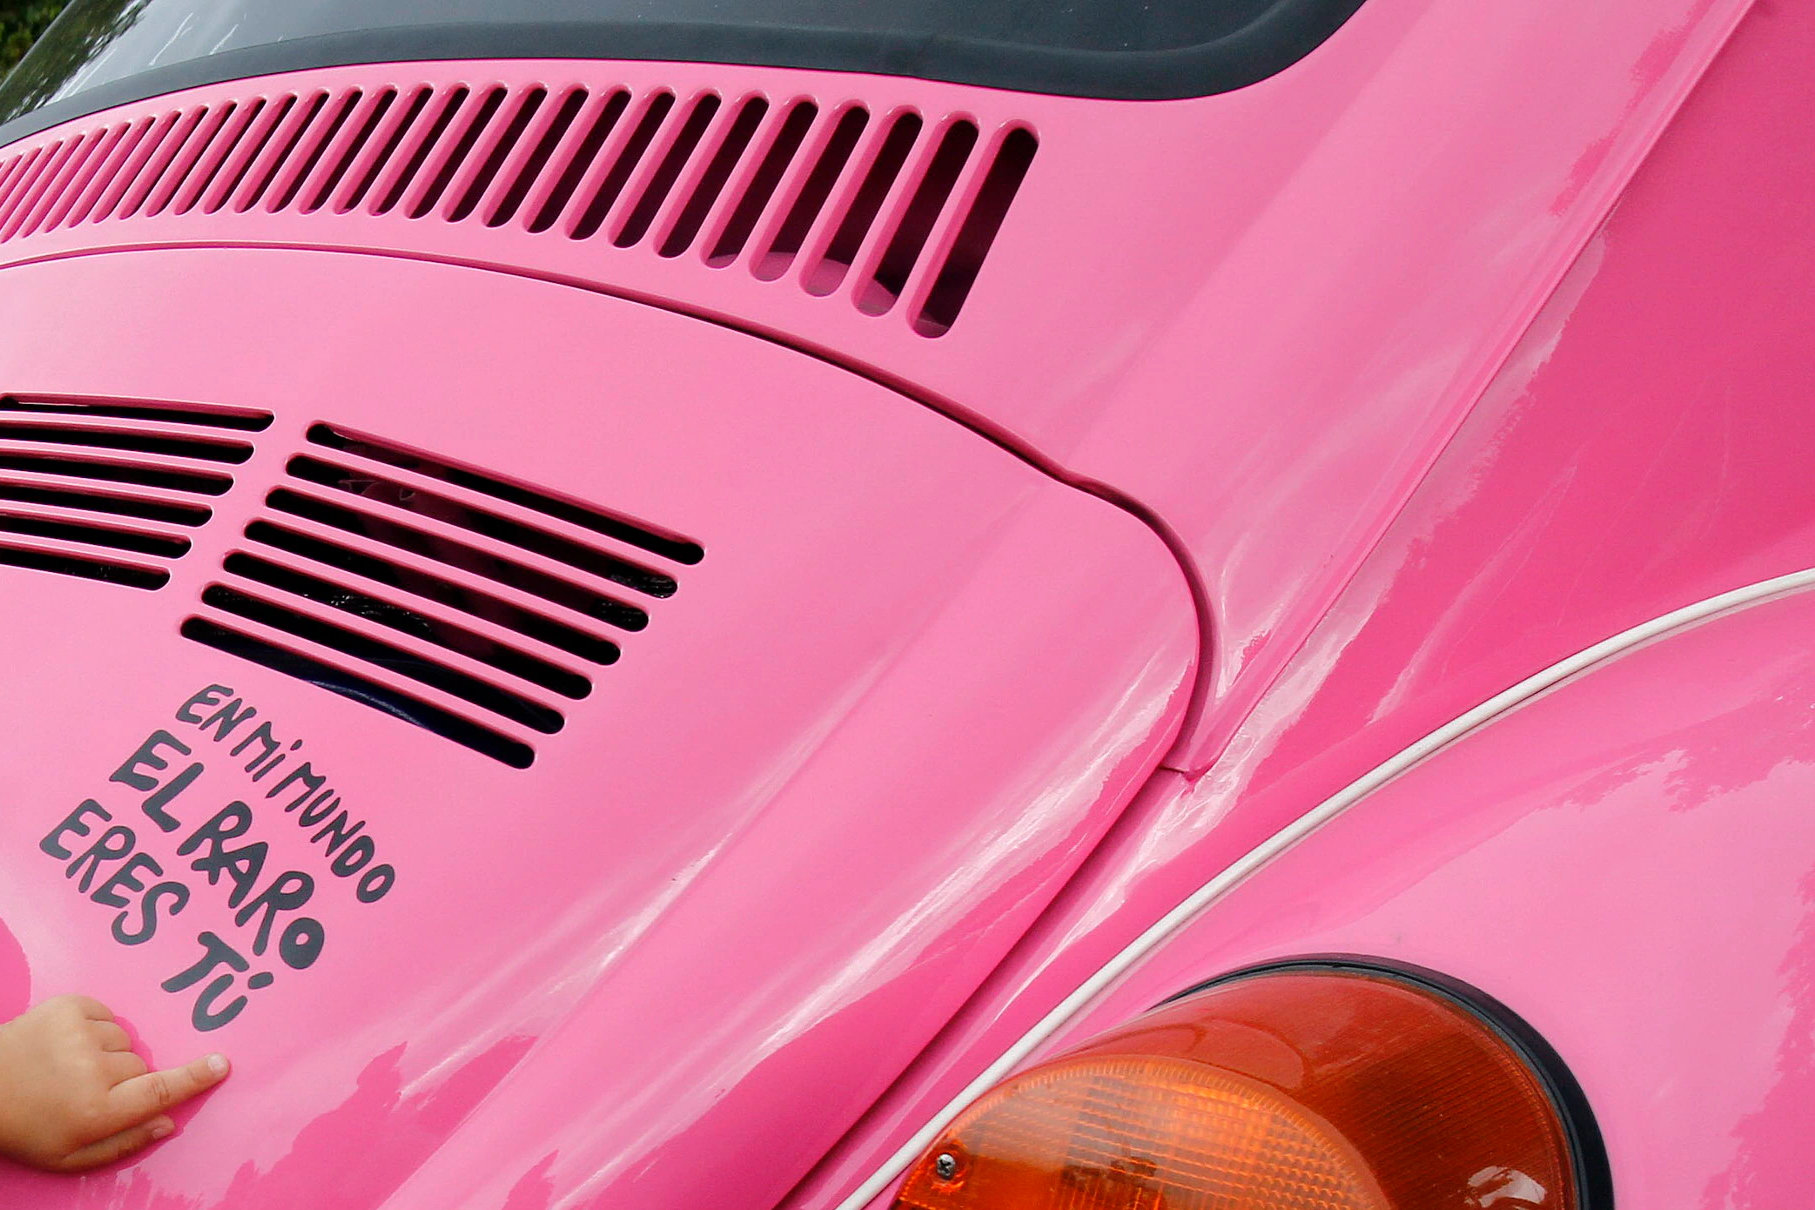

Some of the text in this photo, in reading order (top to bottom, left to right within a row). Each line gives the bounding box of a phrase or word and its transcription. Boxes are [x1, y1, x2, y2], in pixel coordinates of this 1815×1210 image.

[109, 730, 325, 970] EL RARO
[175, 684, 256, 742] EN
[265, 761, 395, 903] MUNDO
[39, 798, 275, 1032] ERES TÚ
